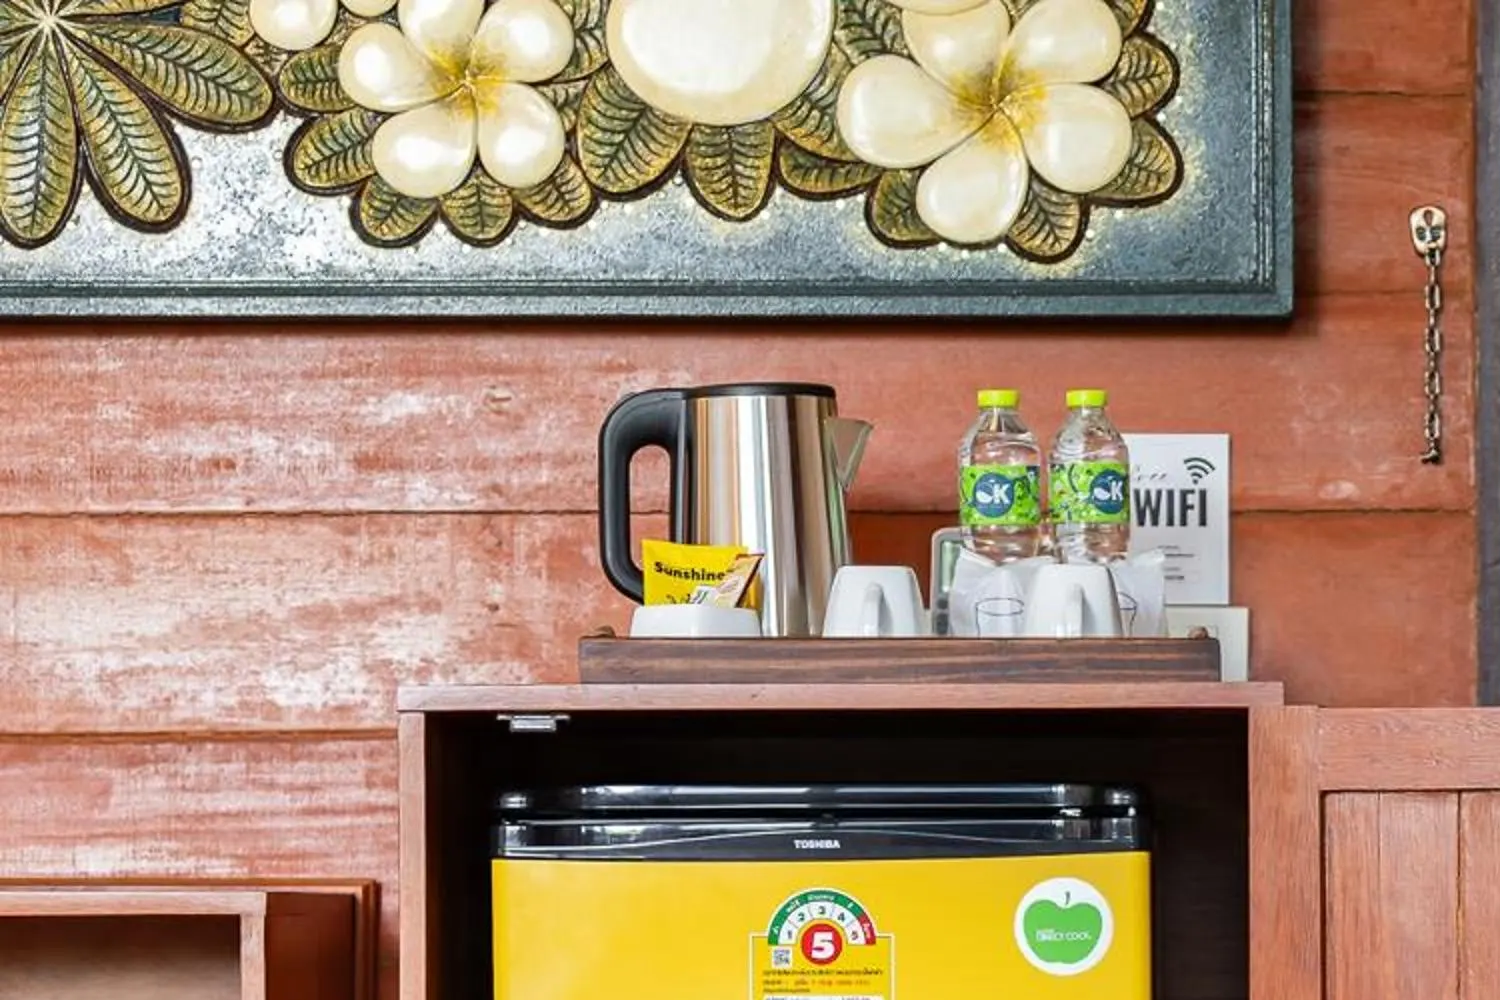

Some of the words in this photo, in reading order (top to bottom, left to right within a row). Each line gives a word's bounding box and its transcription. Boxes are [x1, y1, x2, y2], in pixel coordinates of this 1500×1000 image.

[1134, 488, 1208, 528] WIFI
[653, 561, 726, 582] Sunshine
[793, 839, 841, 849] TOSHIBA
[797, 912, 805, 922] 2
[818, 906, 826, 915] 3
[837, 913, 846, 922] 4
[811, 931, 836, 960] 5
